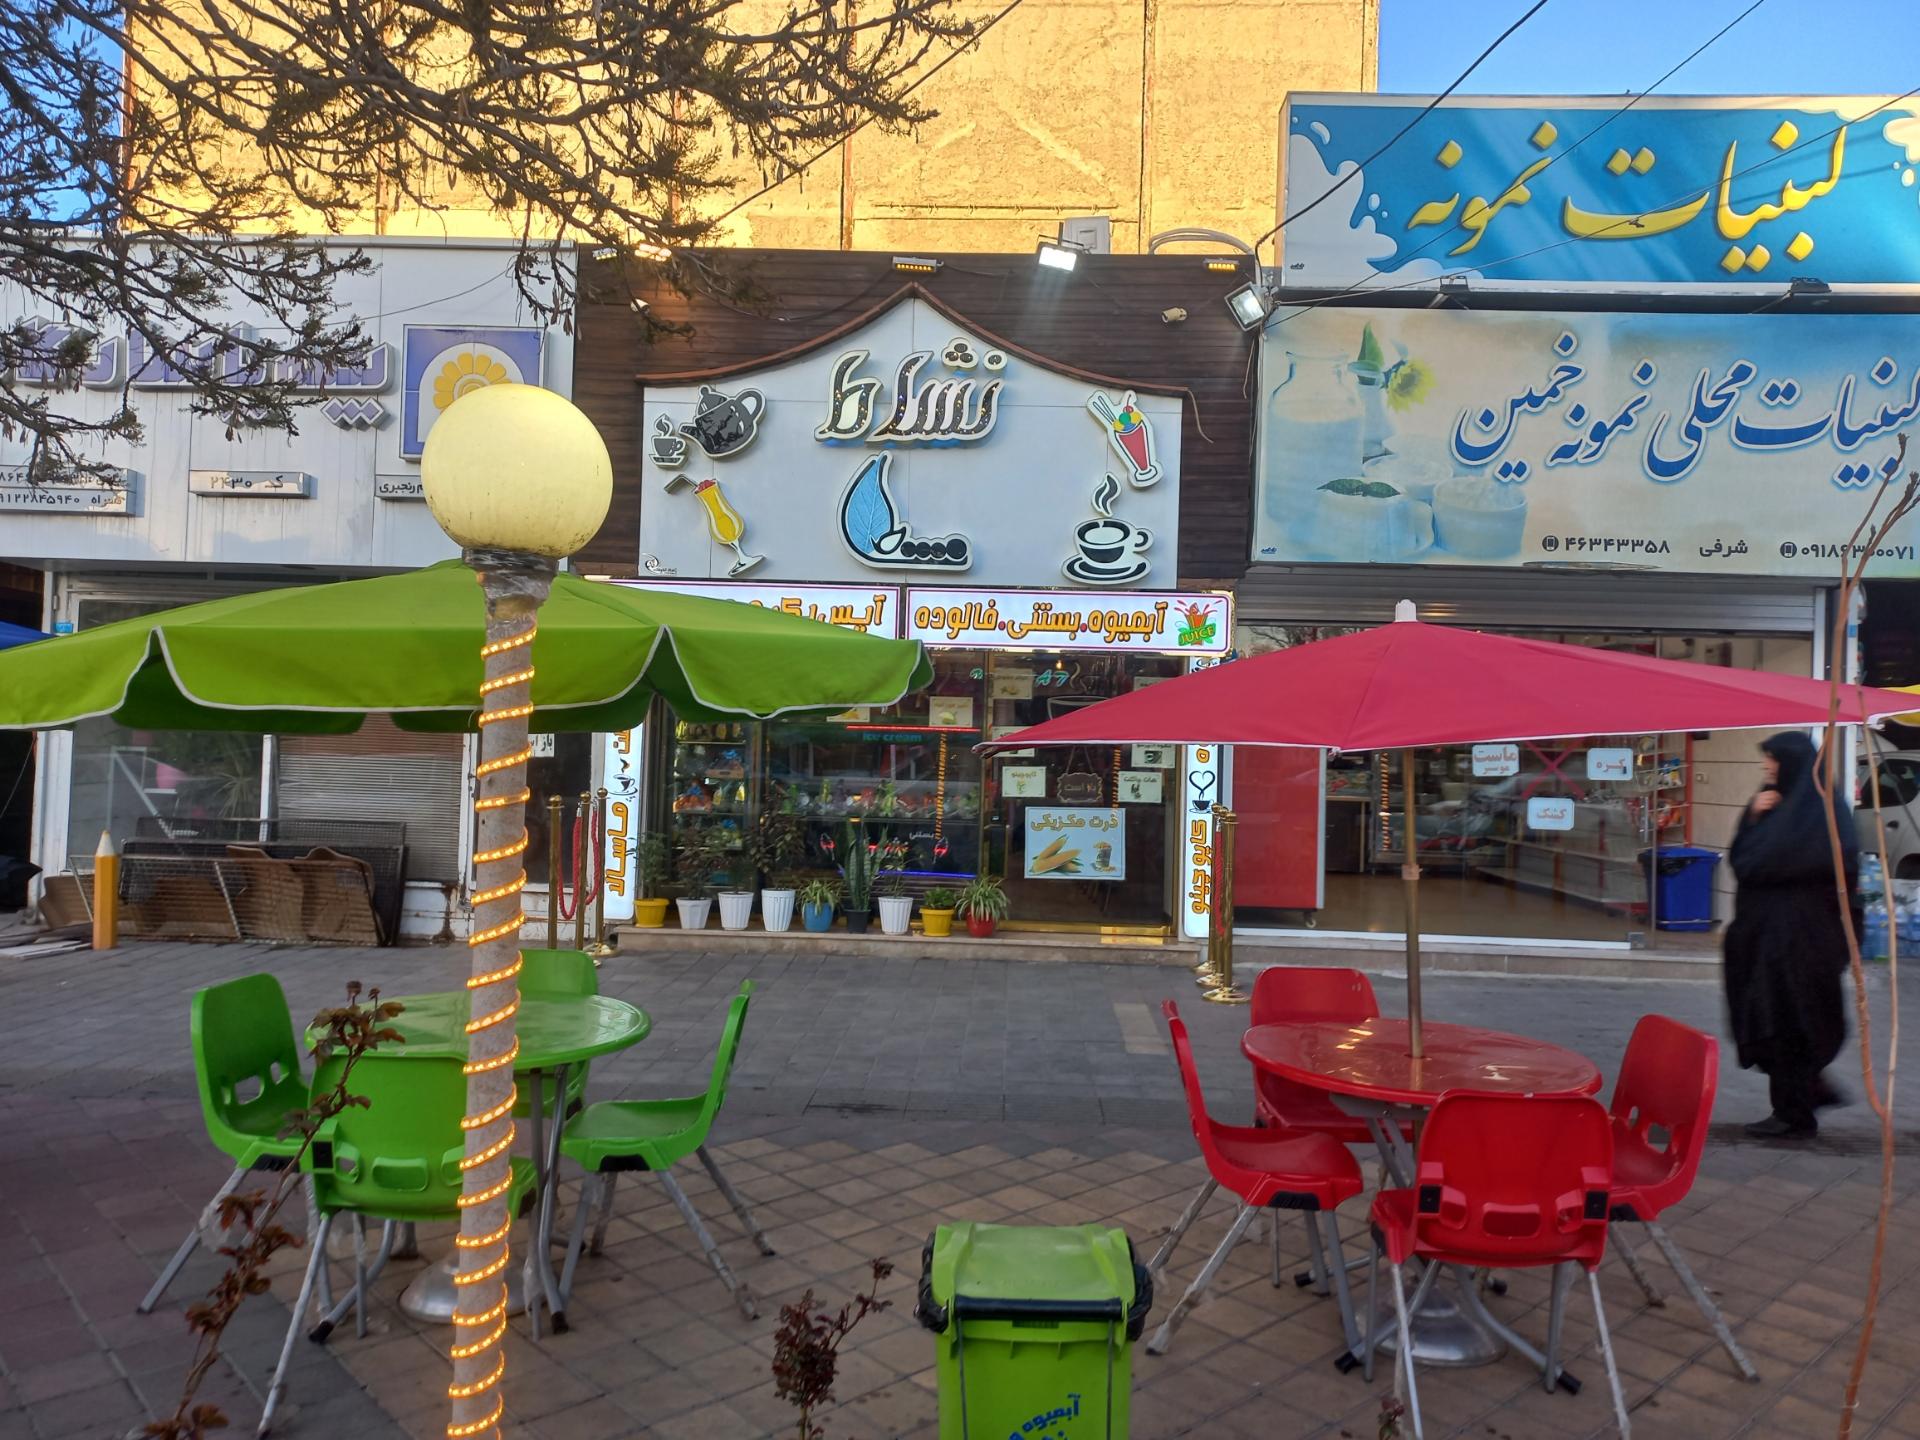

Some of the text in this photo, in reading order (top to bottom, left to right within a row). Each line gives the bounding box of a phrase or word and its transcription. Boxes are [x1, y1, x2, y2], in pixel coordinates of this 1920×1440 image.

[1407, 120, 1848, 273] لبنیات نمونه
[815, 338, 1007, 442] نشاط
[1450, 331, 1587, 485] خمین
[1546, 357, 1656, 470] نمونه
[1641, 359, 1758, 482] محلی
[1565, 537, 1671, 554] ۴۶۳۴۳۳۵۸
[1699, 538, 1749, 558] شرفی
[1181, 625, 1214, 645] JUICE
